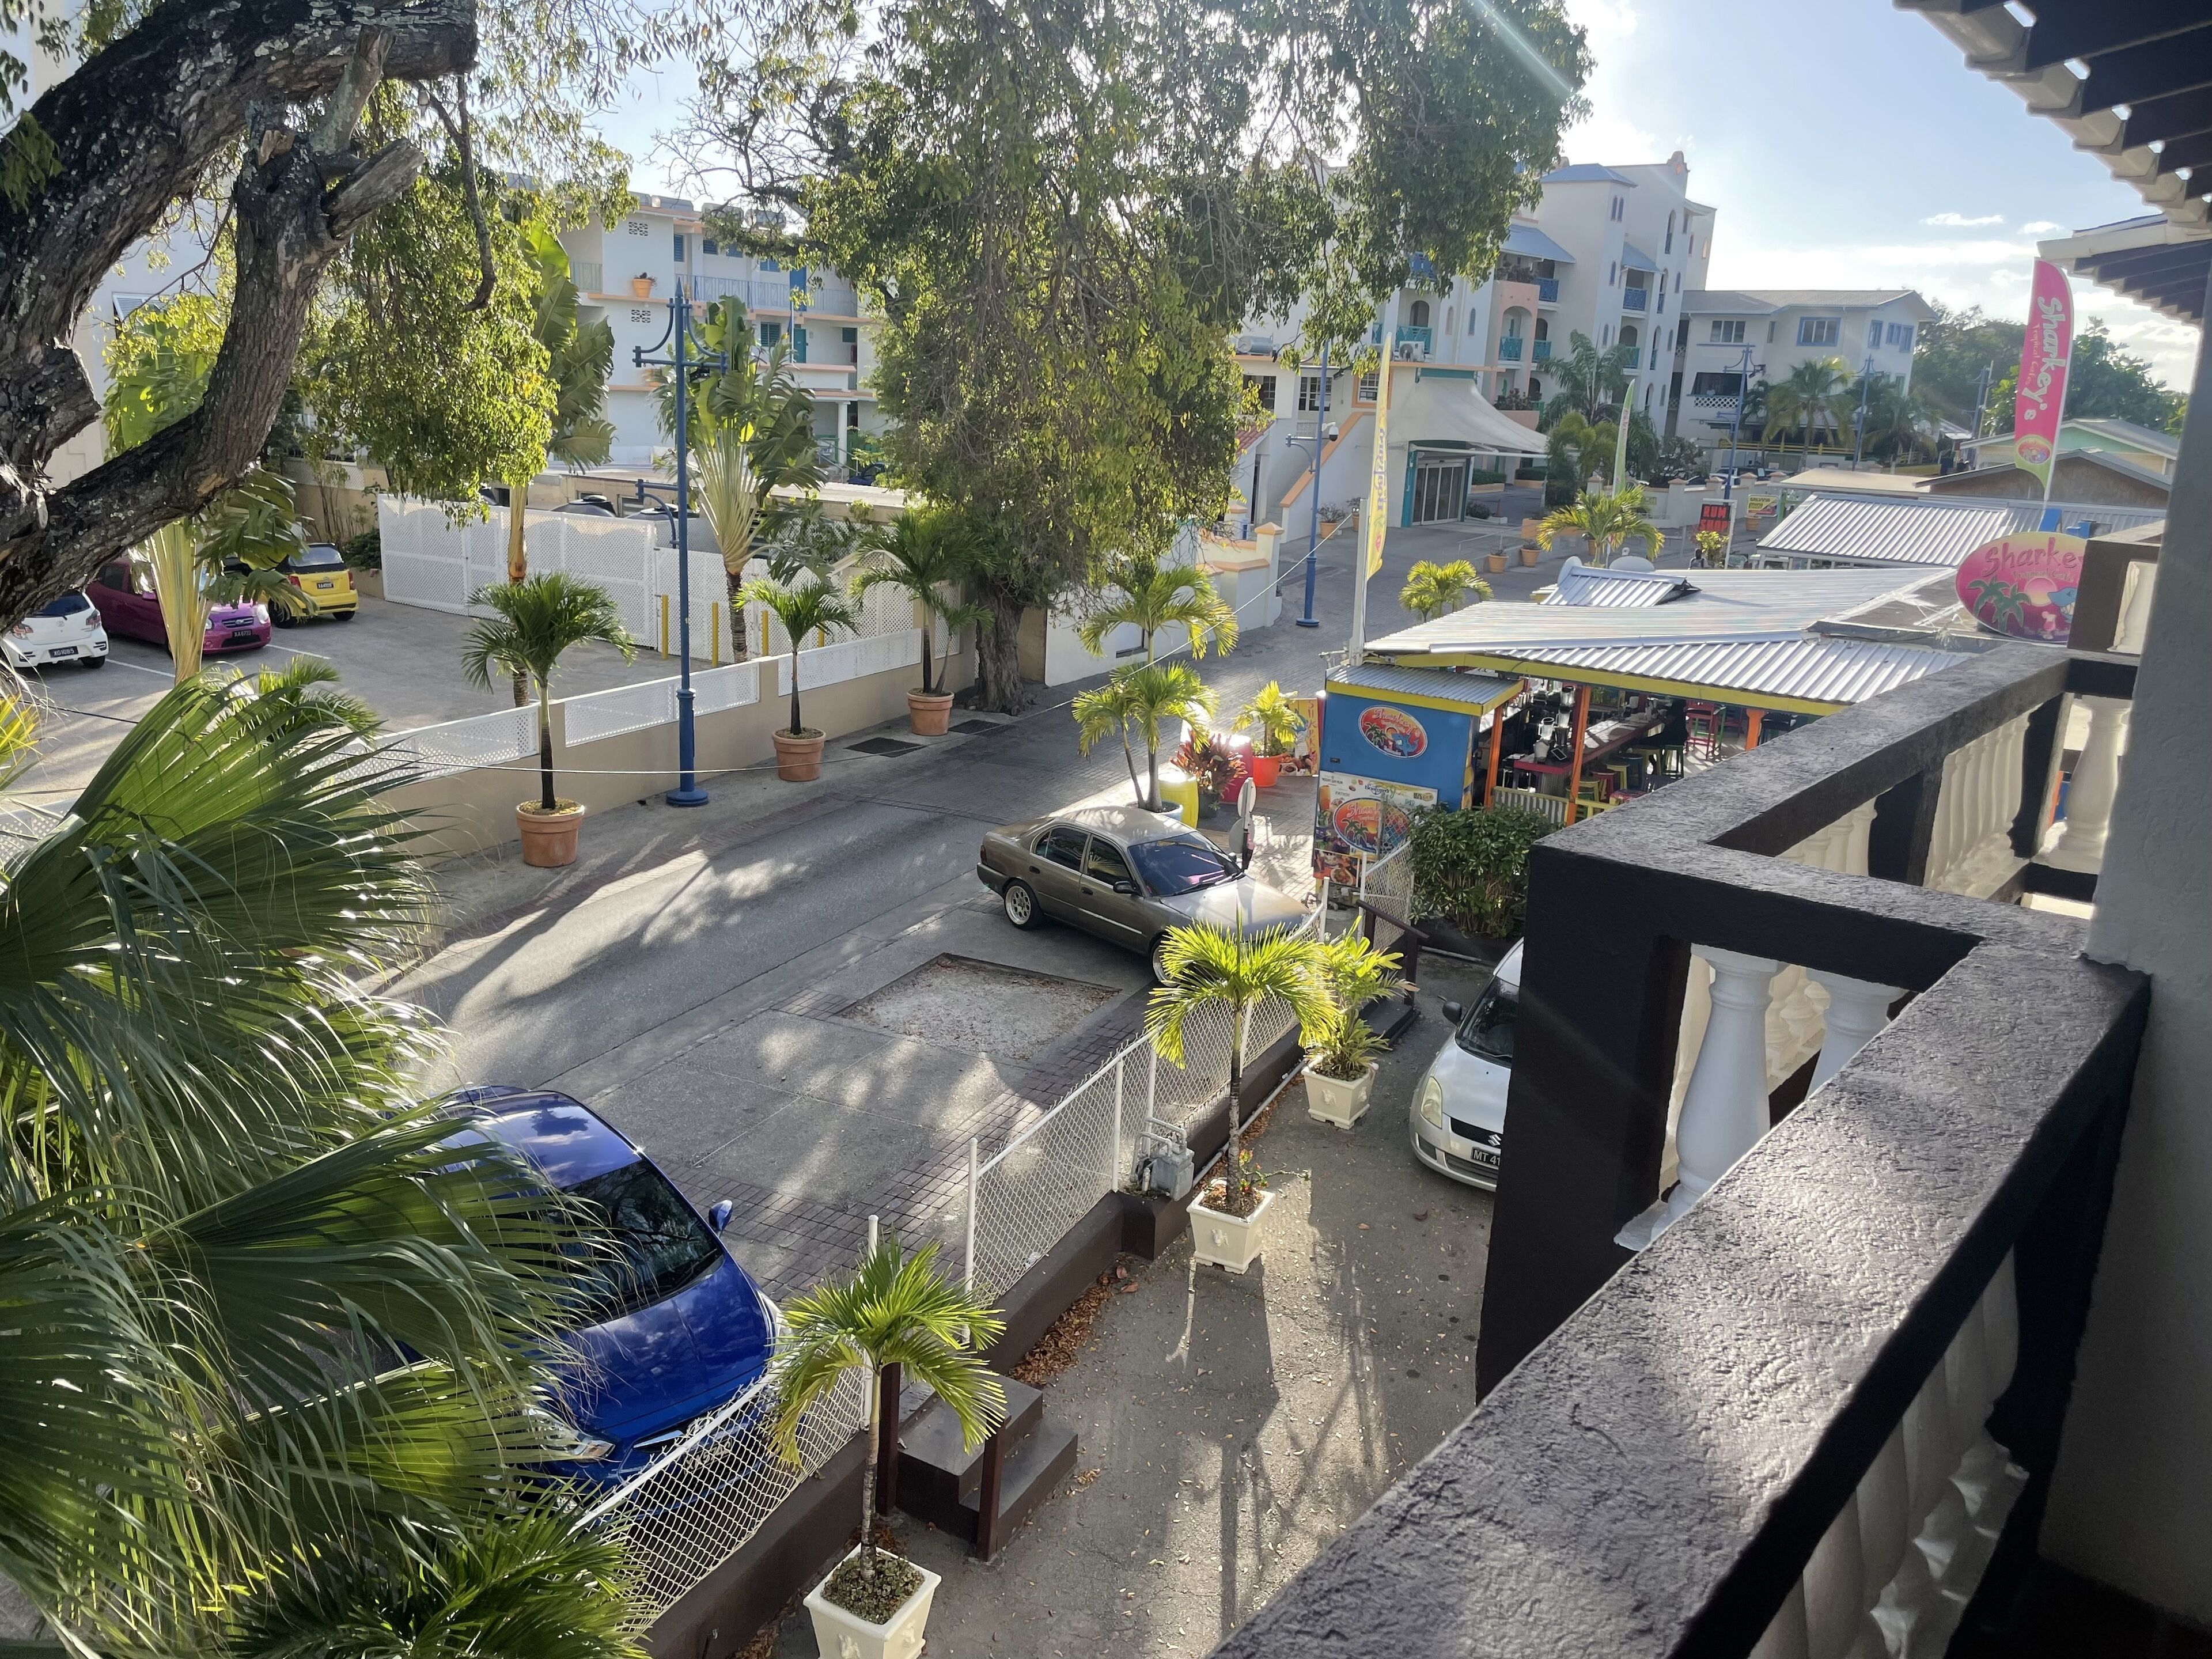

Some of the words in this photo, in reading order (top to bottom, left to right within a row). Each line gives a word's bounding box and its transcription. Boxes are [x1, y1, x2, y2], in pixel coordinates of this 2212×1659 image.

[2021, 296, 2067, 421] Sharkey's
[2030, 323, 2040, 359] Tropical
[1703, 506, 1727, 518] RUM
[1983, 537, 2084, 577] Sharke
[1474, 1149, 1489, 1162] MT
